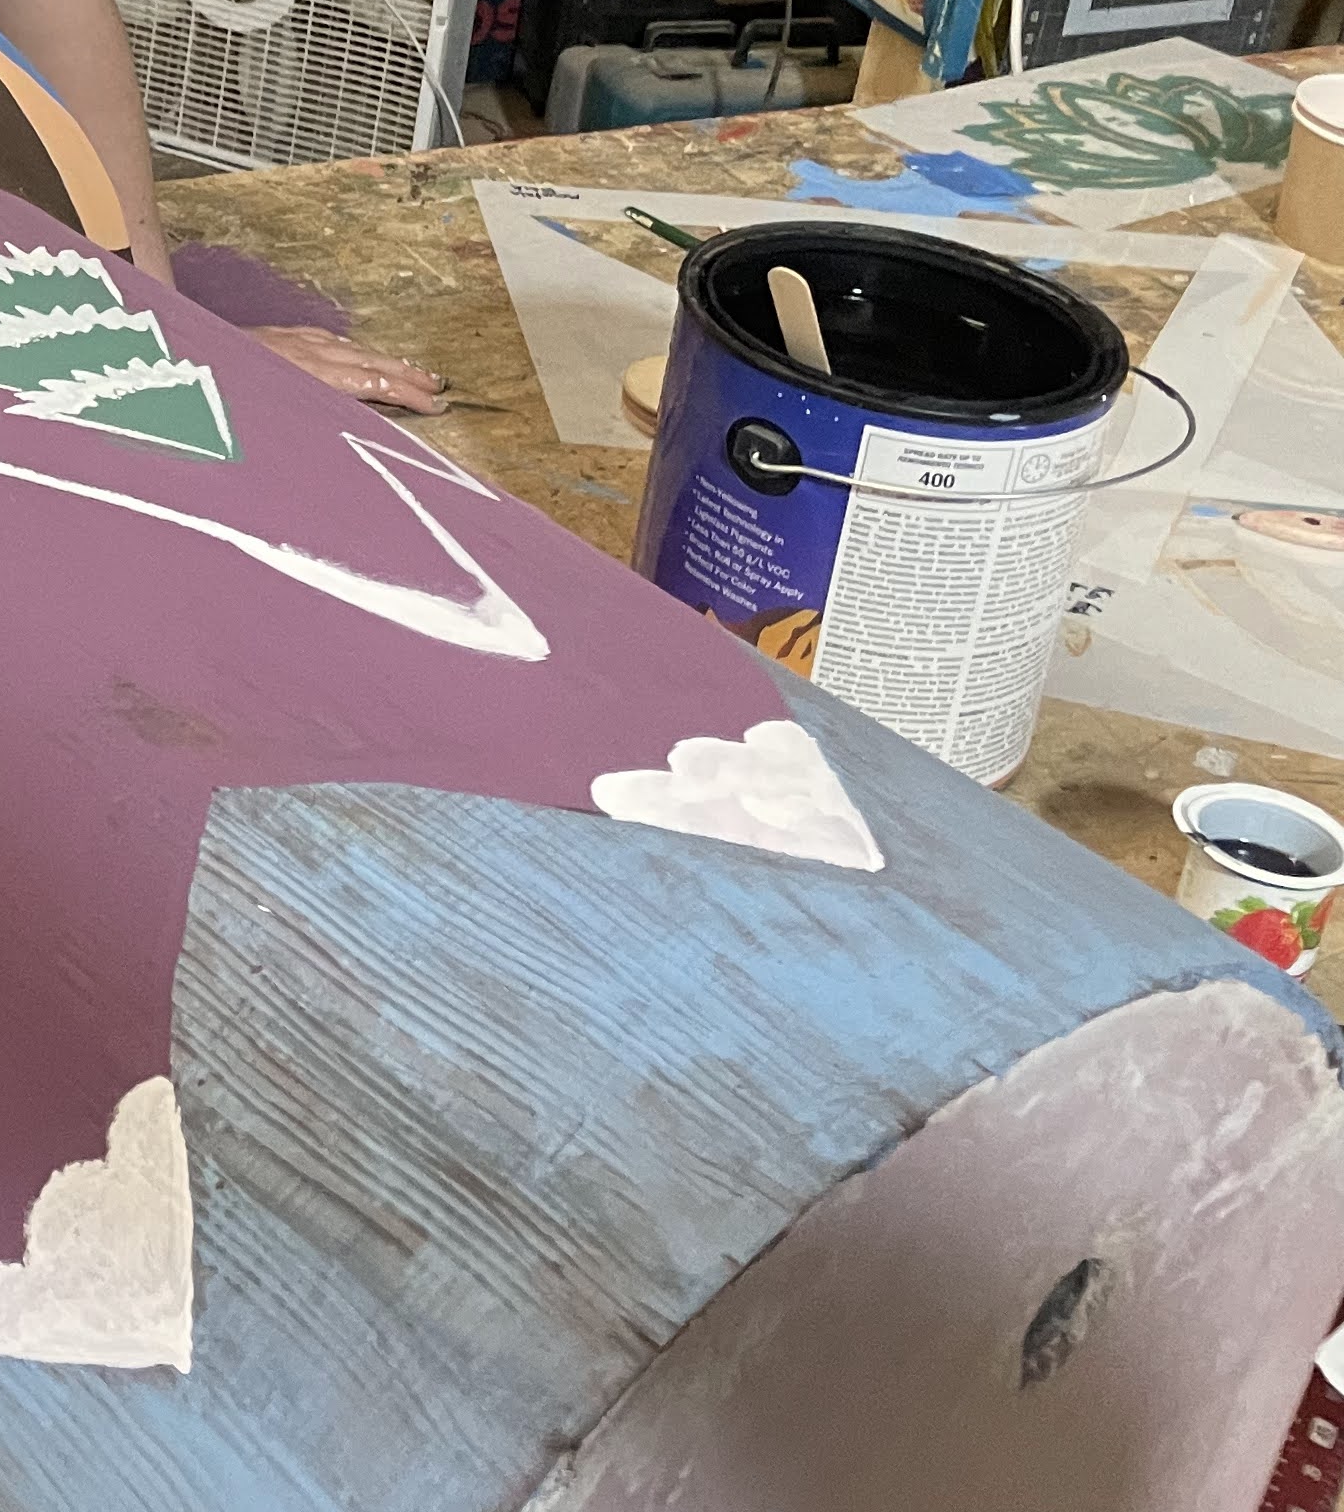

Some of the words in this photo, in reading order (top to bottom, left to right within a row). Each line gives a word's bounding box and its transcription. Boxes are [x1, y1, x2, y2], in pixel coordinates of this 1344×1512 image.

[918, 471, 956, 489] 400
[767, 562, 791, 580] VOC
[731, 576, 757, 594] Color
[732, 563, 742, 572] or
[744, 566, 772, 588] Spray
[773, 581, 804, 601] Apply
